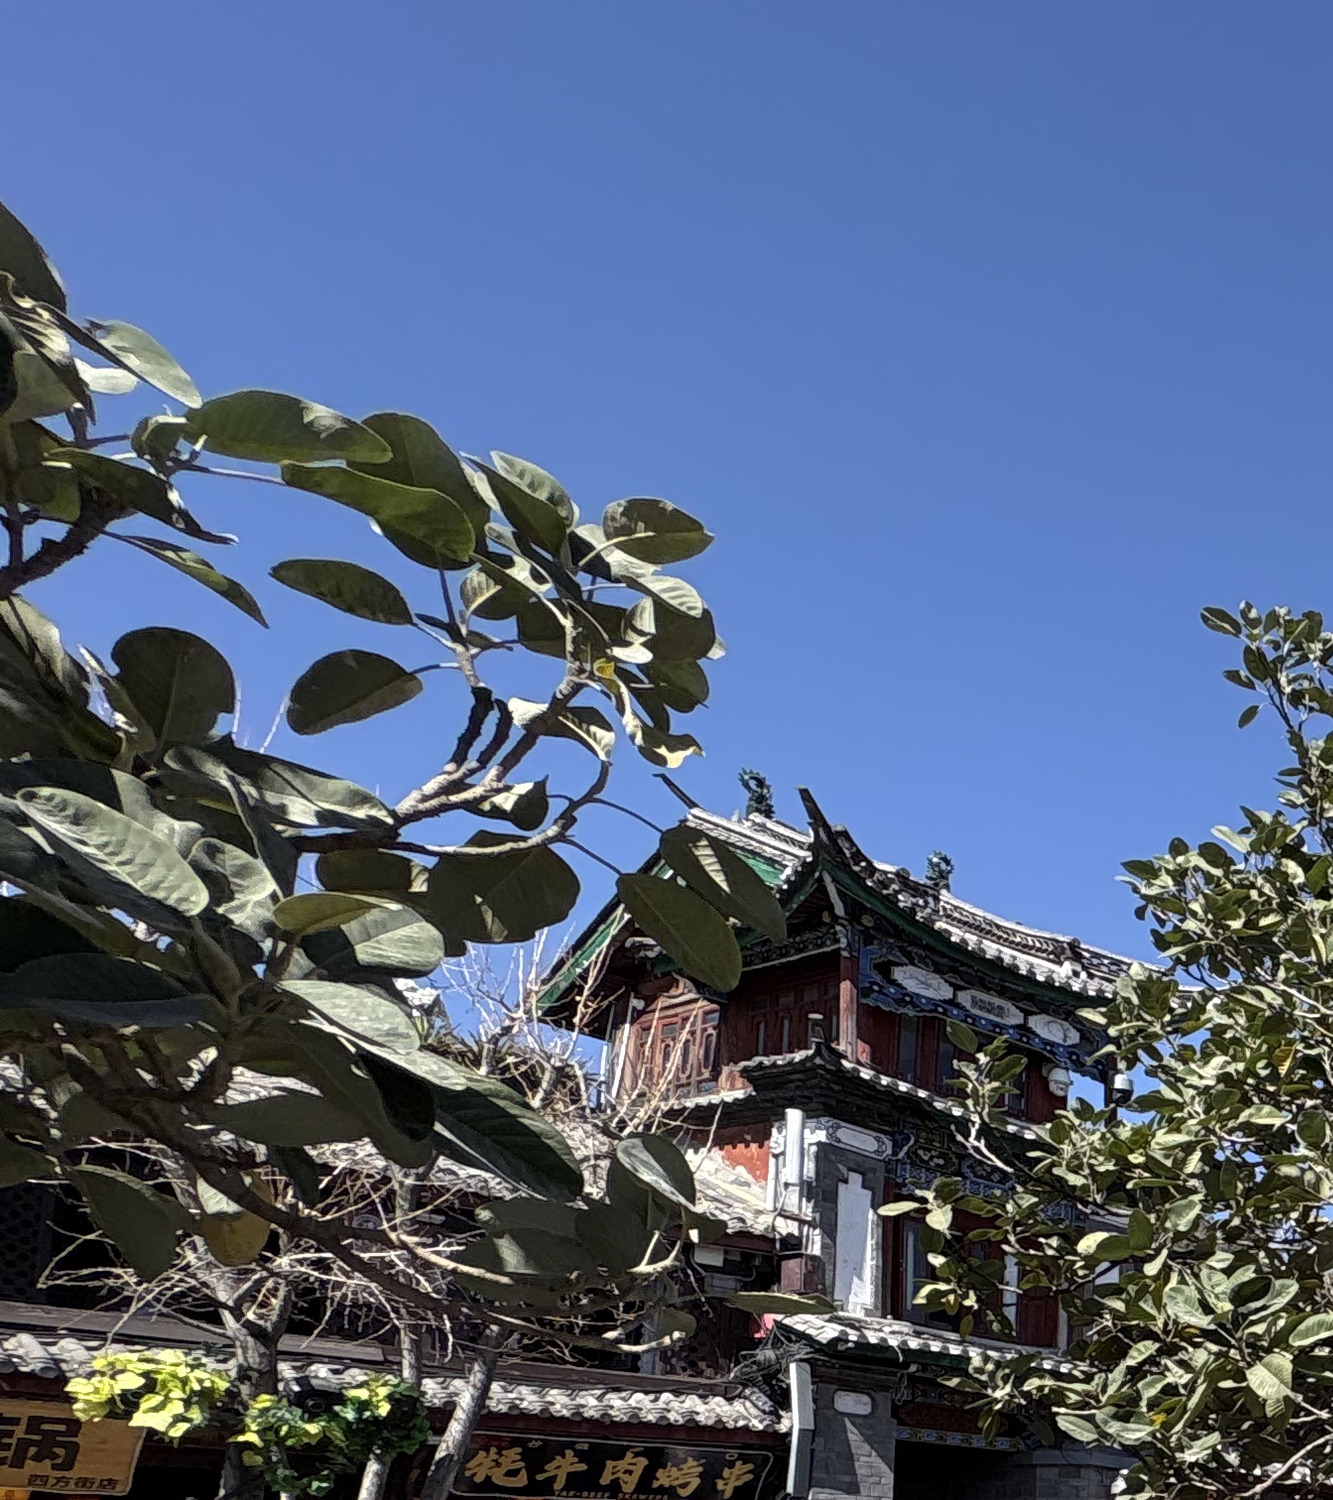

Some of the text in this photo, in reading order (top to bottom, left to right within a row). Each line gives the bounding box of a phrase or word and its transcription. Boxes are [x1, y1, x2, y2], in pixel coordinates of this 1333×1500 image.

[27, 1474, 120, 1491] 四方街店
[463, 1446, 755, 1500] 牦牛肉烤串
